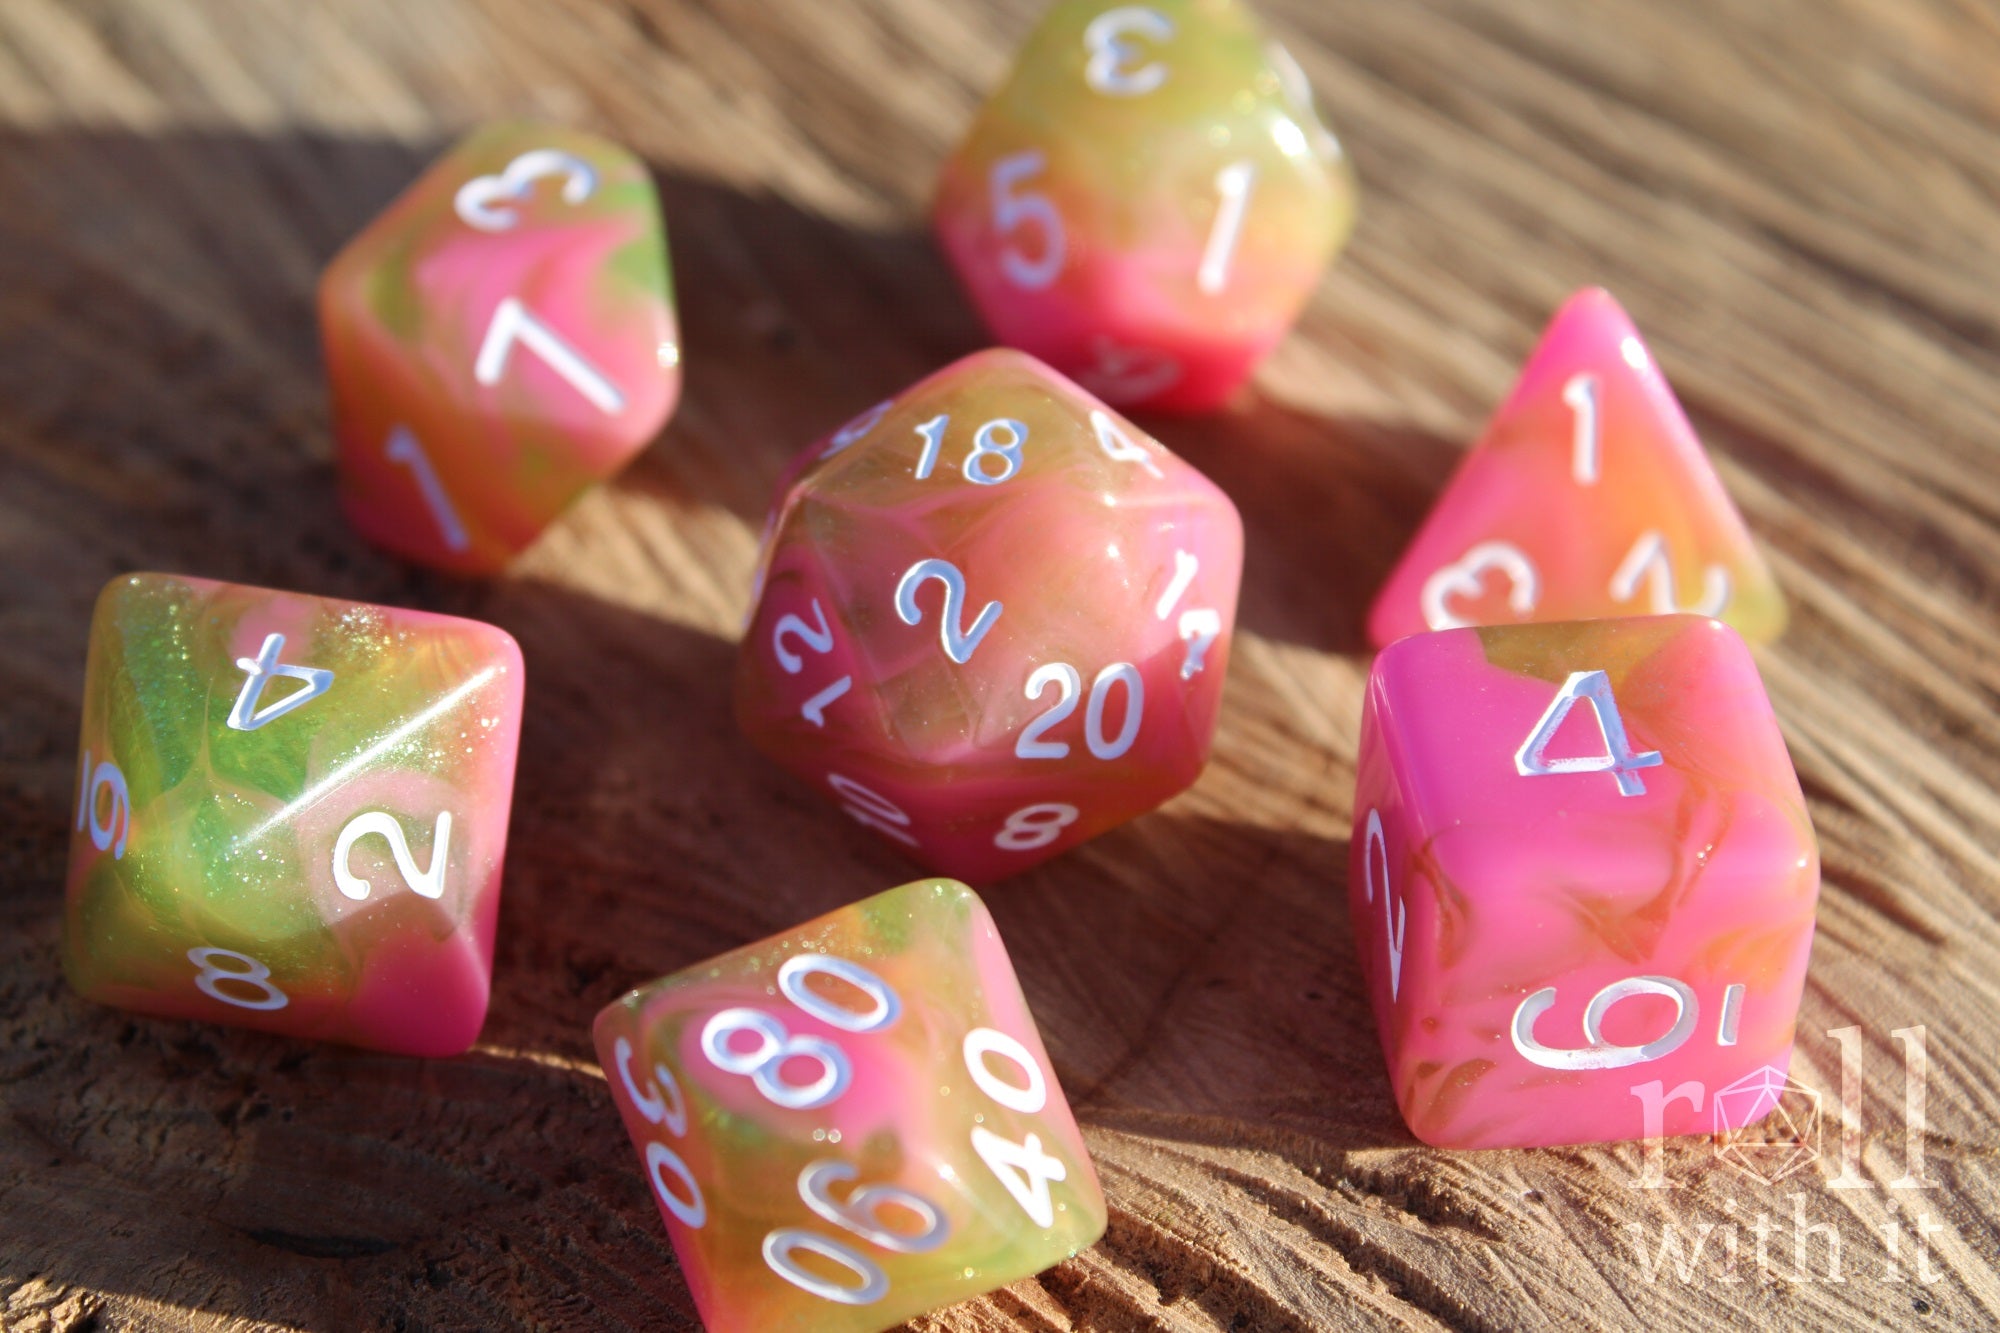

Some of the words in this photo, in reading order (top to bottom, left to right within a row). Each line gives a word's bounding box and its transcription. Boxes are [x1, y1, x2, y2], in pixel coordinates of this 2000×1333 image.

[1082, 4, 1175, 95] 3
[454, 148, 600, 233] 3
[988, 149, 1066, 290] 5
[1198, 160, 1257, 294] 1
[474, 296, 625, 414] 7
[912, 413, 1030, 486] 18
[1089, 409, 1164, 478] 4
[1562, 373, 1598, 484] 1
[384, 422, 471, 552] 1
[895, 558, 1004, 664] 2
[1420, 540, 1540, 632] 3
[227, 633, 335, 731] 4
[774, 597, 853, 728] 12
[1015, 662, 1146, 761] 20
[1514, 669, 1665, 797] 4
[333, 811, 453, 901] 2
[994, 803, 1080, 851] 8
[1364, 808, 1406, 1004] 2
[187, 946, 289, 1011] 8
[701, 953, 902, 1110] 80
[613, 1037, 707, 1229] 30
[963, 1027, 1068, 1229] 40
